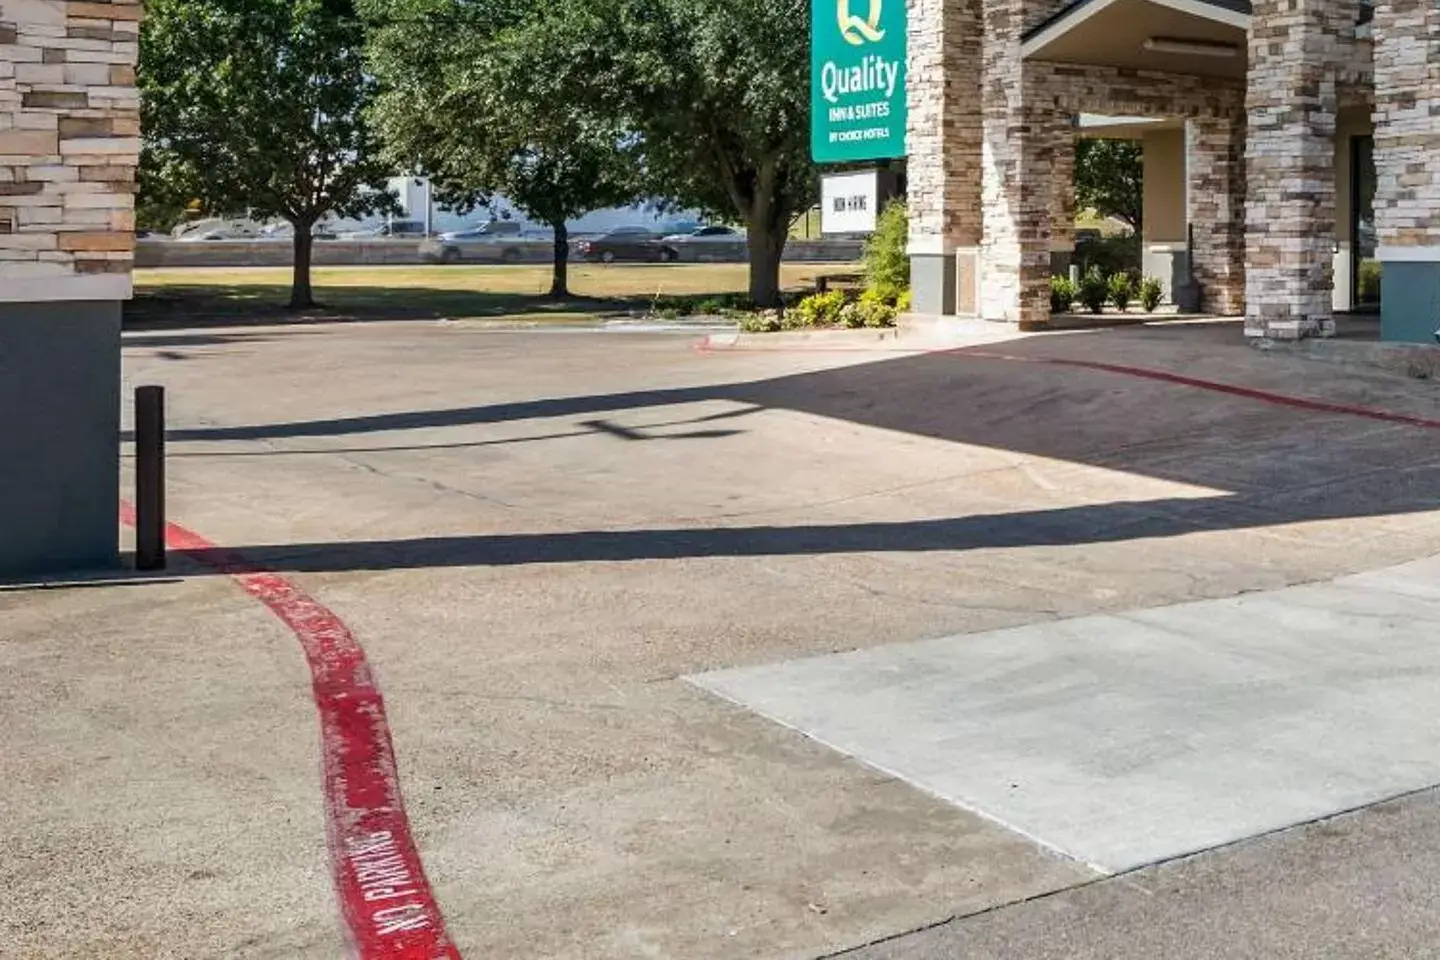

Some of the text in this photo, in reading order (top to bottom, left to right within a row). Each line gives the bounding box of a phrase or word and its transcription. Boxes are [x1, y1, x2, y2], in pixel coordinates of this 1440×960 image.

[821, 55, 898, 103] Quality
[829, 107, 846, 122] INN
[855, 101, 890, 120] SUITES
[344, 830, 430, 935] NO PARKING
